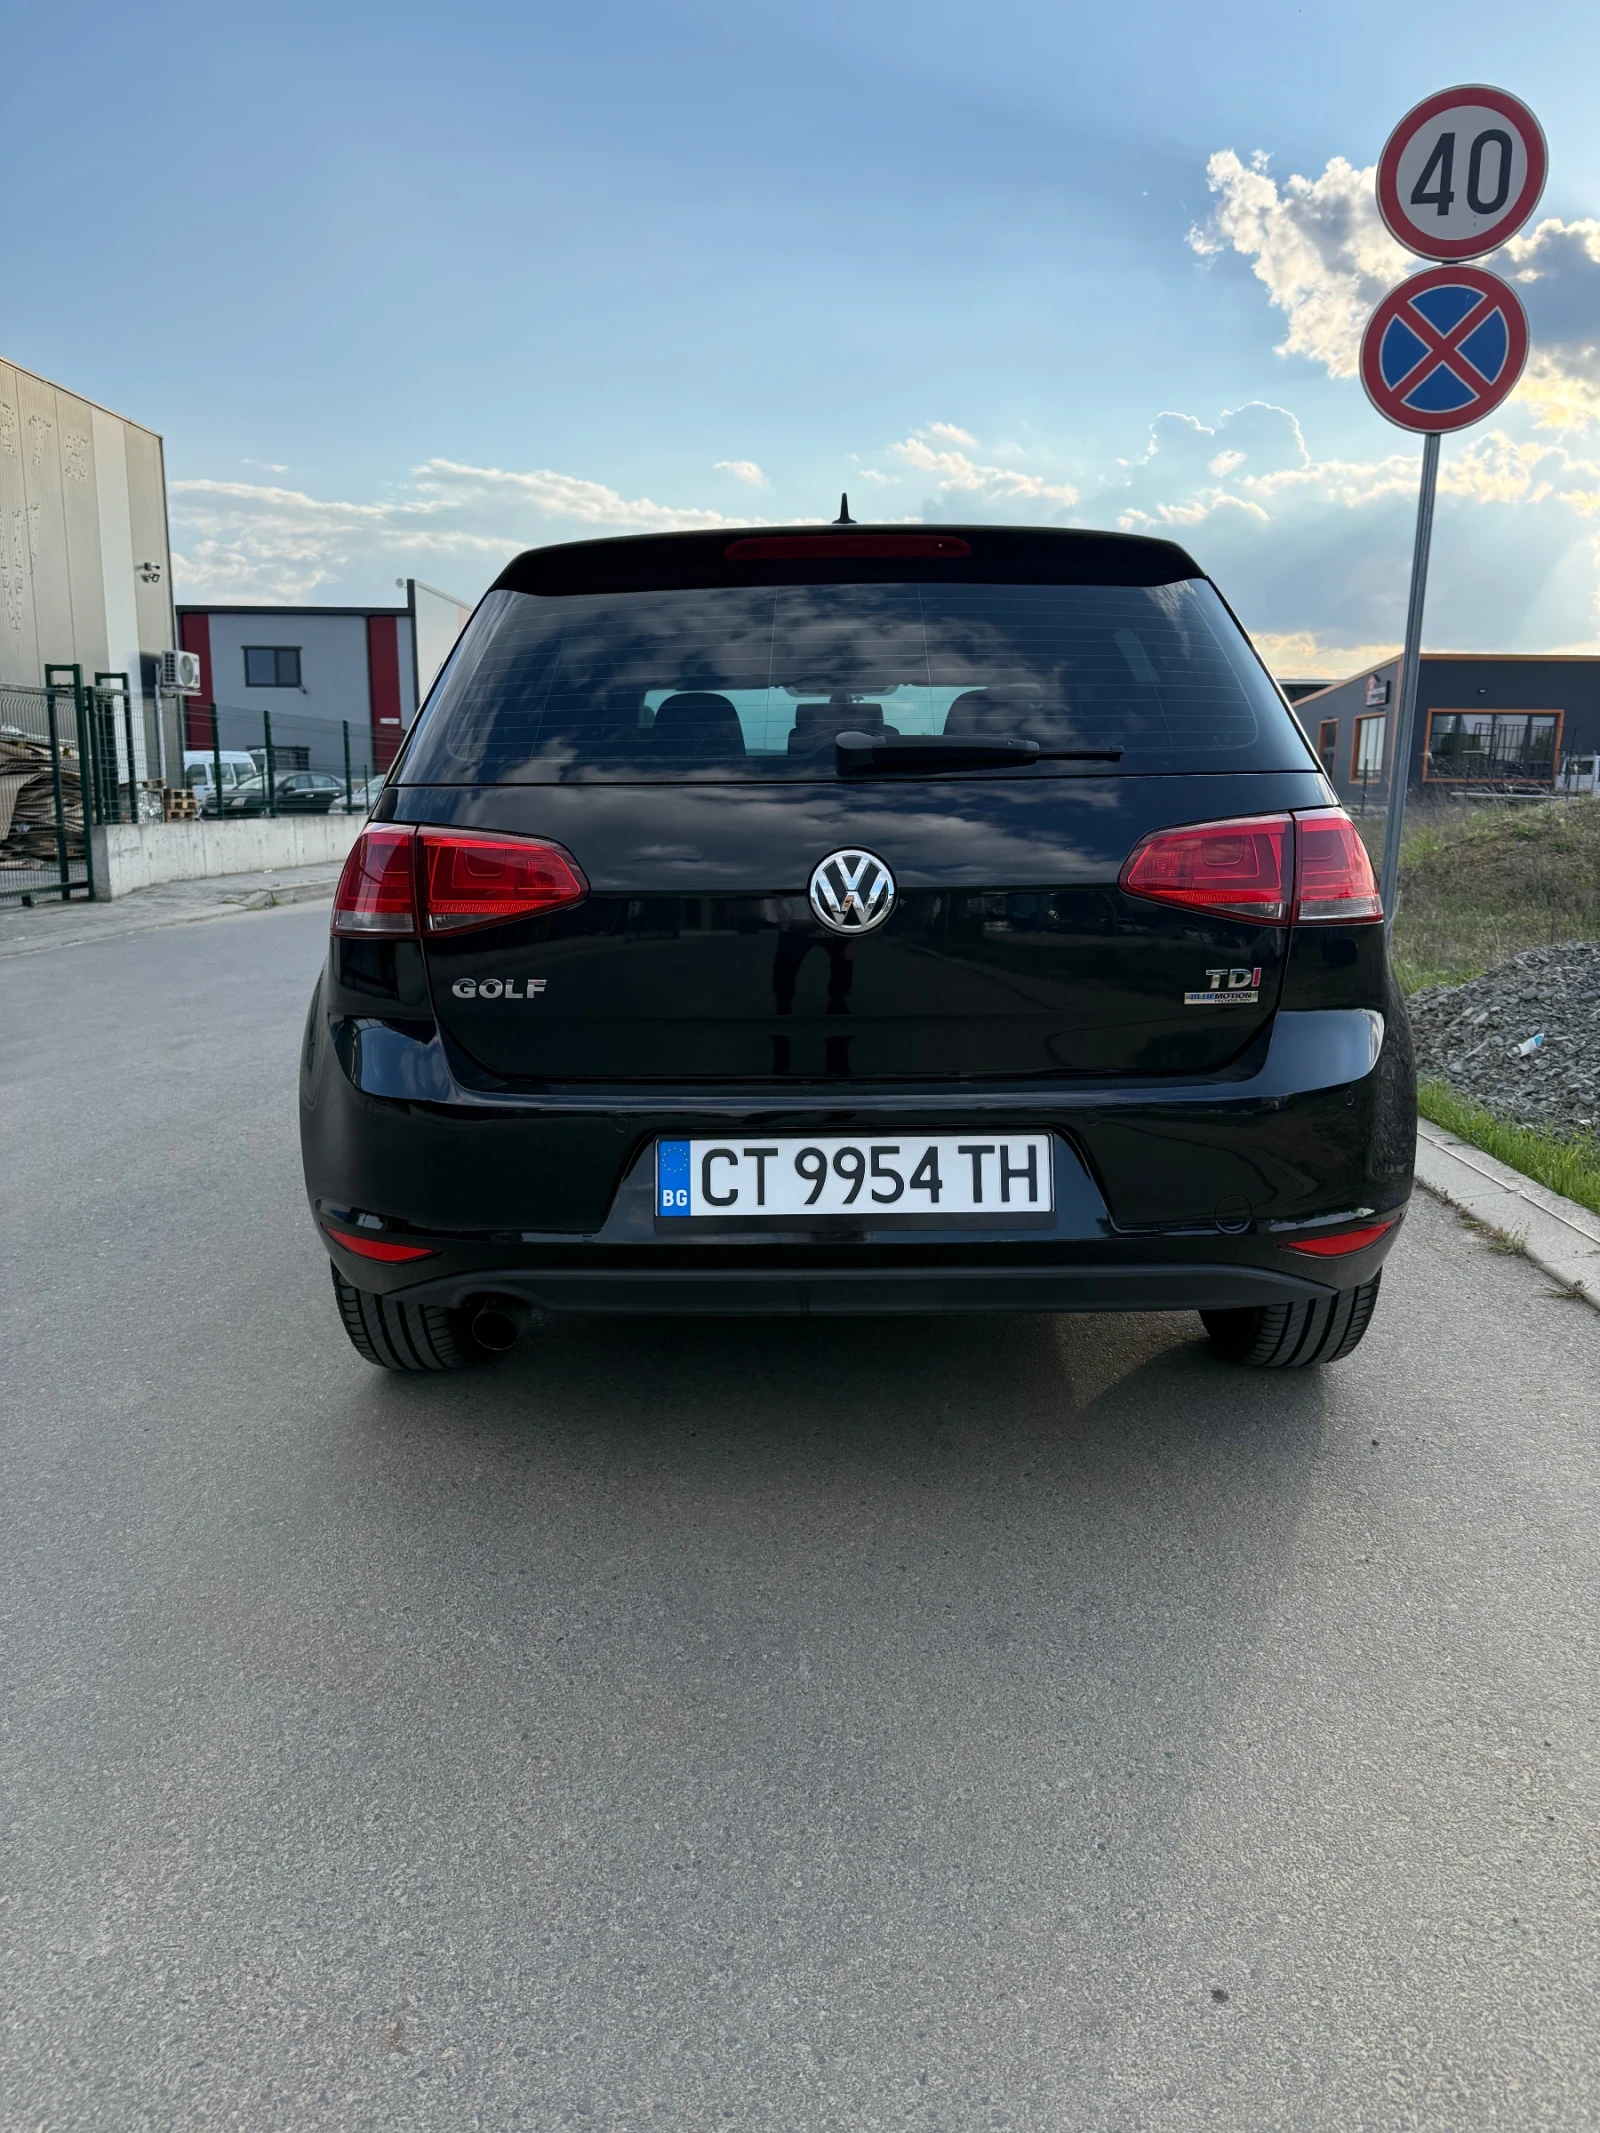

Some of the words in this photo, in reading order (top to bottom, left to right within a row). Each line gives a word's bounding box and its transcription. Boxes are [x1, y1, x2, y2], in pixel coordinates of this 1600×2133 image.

[1410, 129, 1513, 216] 40
[452, 978, 547, 999] GOLF
[1205, 967, 1262, 989] TDI
[1190, 991, 1252, 1000] BLUEMOTION
[701, 1147, 779, 1208] CT
[794, 1145, 943, 1206] 9954
[957, 1144, 1038, 1204] TH
[663, 1189, 688, 1207] BG
